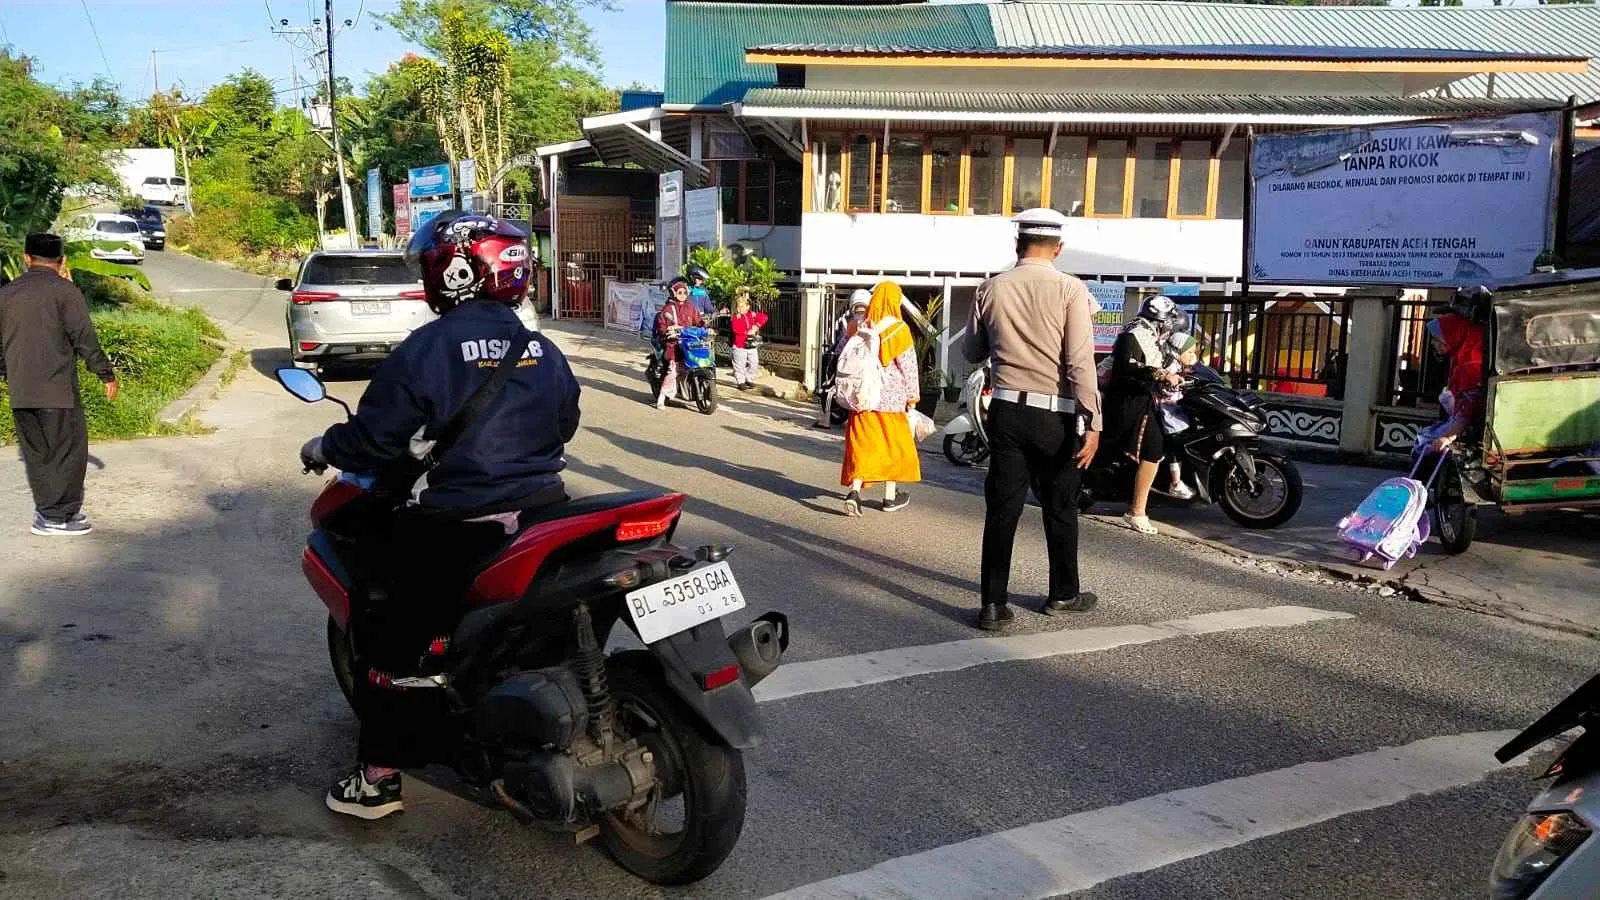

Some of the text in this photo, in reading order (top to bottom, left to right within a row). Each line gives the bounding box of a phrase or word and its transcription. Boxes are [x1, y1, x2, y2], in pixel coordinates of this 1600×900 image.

[1343, 152, 1439, 171] TANPA ROKOK
[1345, 178, 1377, 188] MENJUAL
[1380, 177, 1396, 186] DAN
[1399, 175, 1434, 185] PROMOSI
[1437, 173, 1465, 183] ROKOK
[1468, 173, 1476, 183] DI
[1479, 171, 1509, 182] TEMPAT
[1512, 171, 1525, 181] INI
[1342, 238, 1399, 249] KABUPATEN
[1402, 239, 1428, 249] ACEH
[1432, 237, 1476, 249] TENGAH
[1351, 269, 1390, 277] KESEHATAN
[1392, 269, 1411, 277] ACEH
[461, 339, 543, 362] DISB
[632, 569, 731, 618] BL 5358 GAA
[698, 593, 737, 614] 03 26
